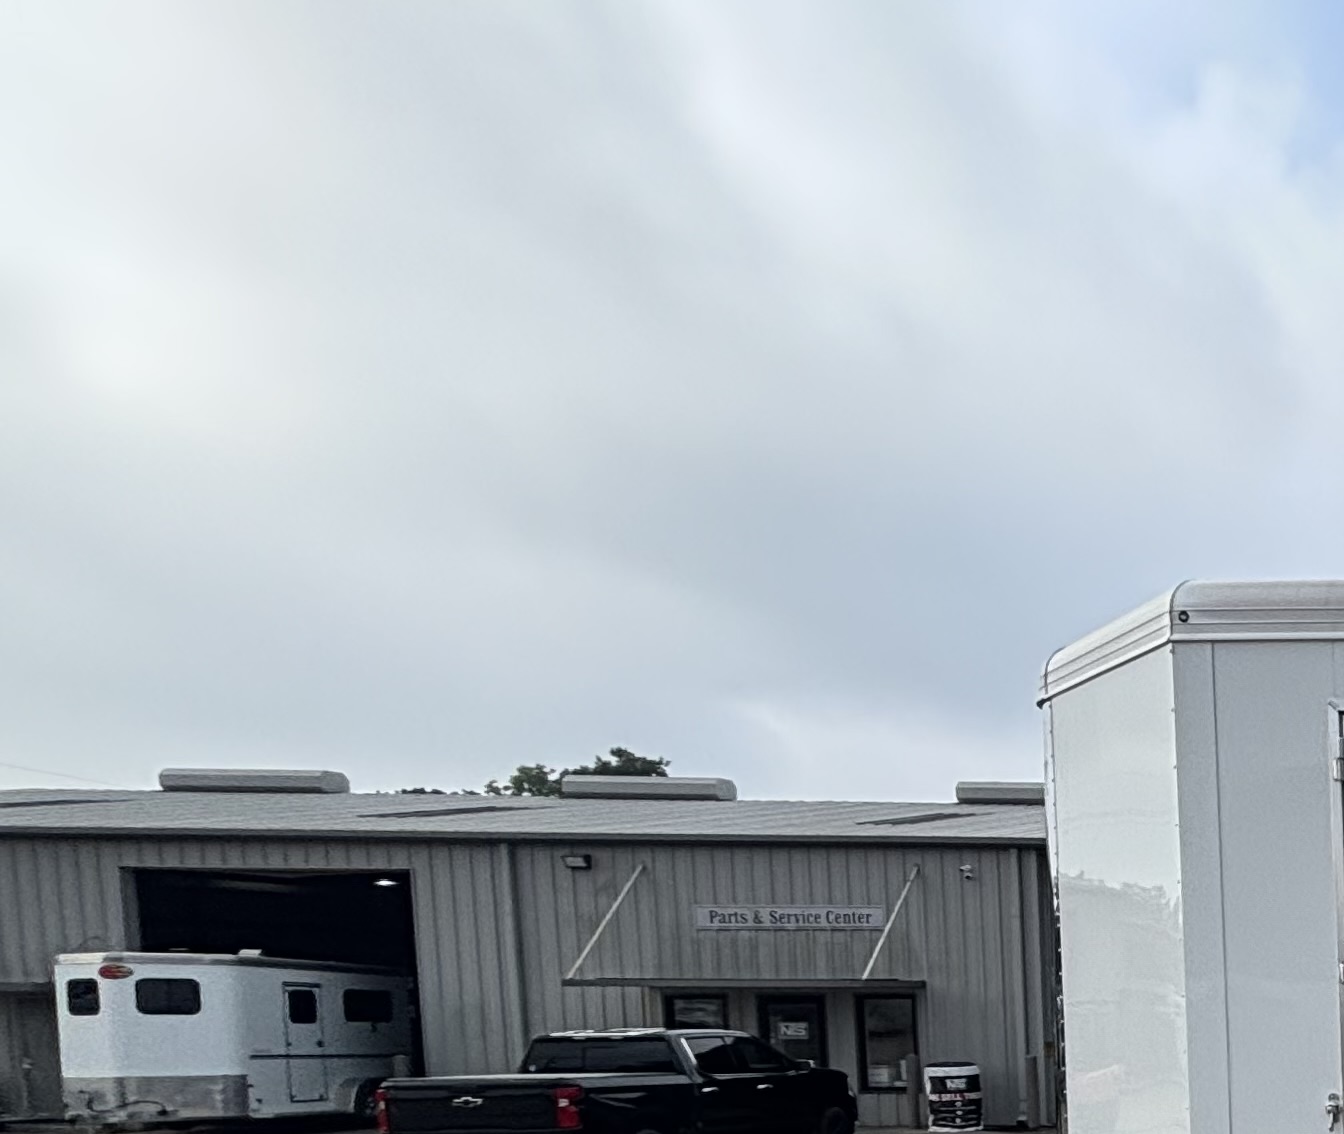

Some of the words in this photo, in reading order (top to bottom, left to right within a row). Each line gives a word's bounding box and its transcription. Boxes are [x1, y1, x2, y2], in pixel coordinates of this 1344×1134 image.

[708, 910, 748, 924] Parts
[752, 910, 764, 924] &
[769, 910, 821, 924] Service
[826, 910, 872, 924] Center
